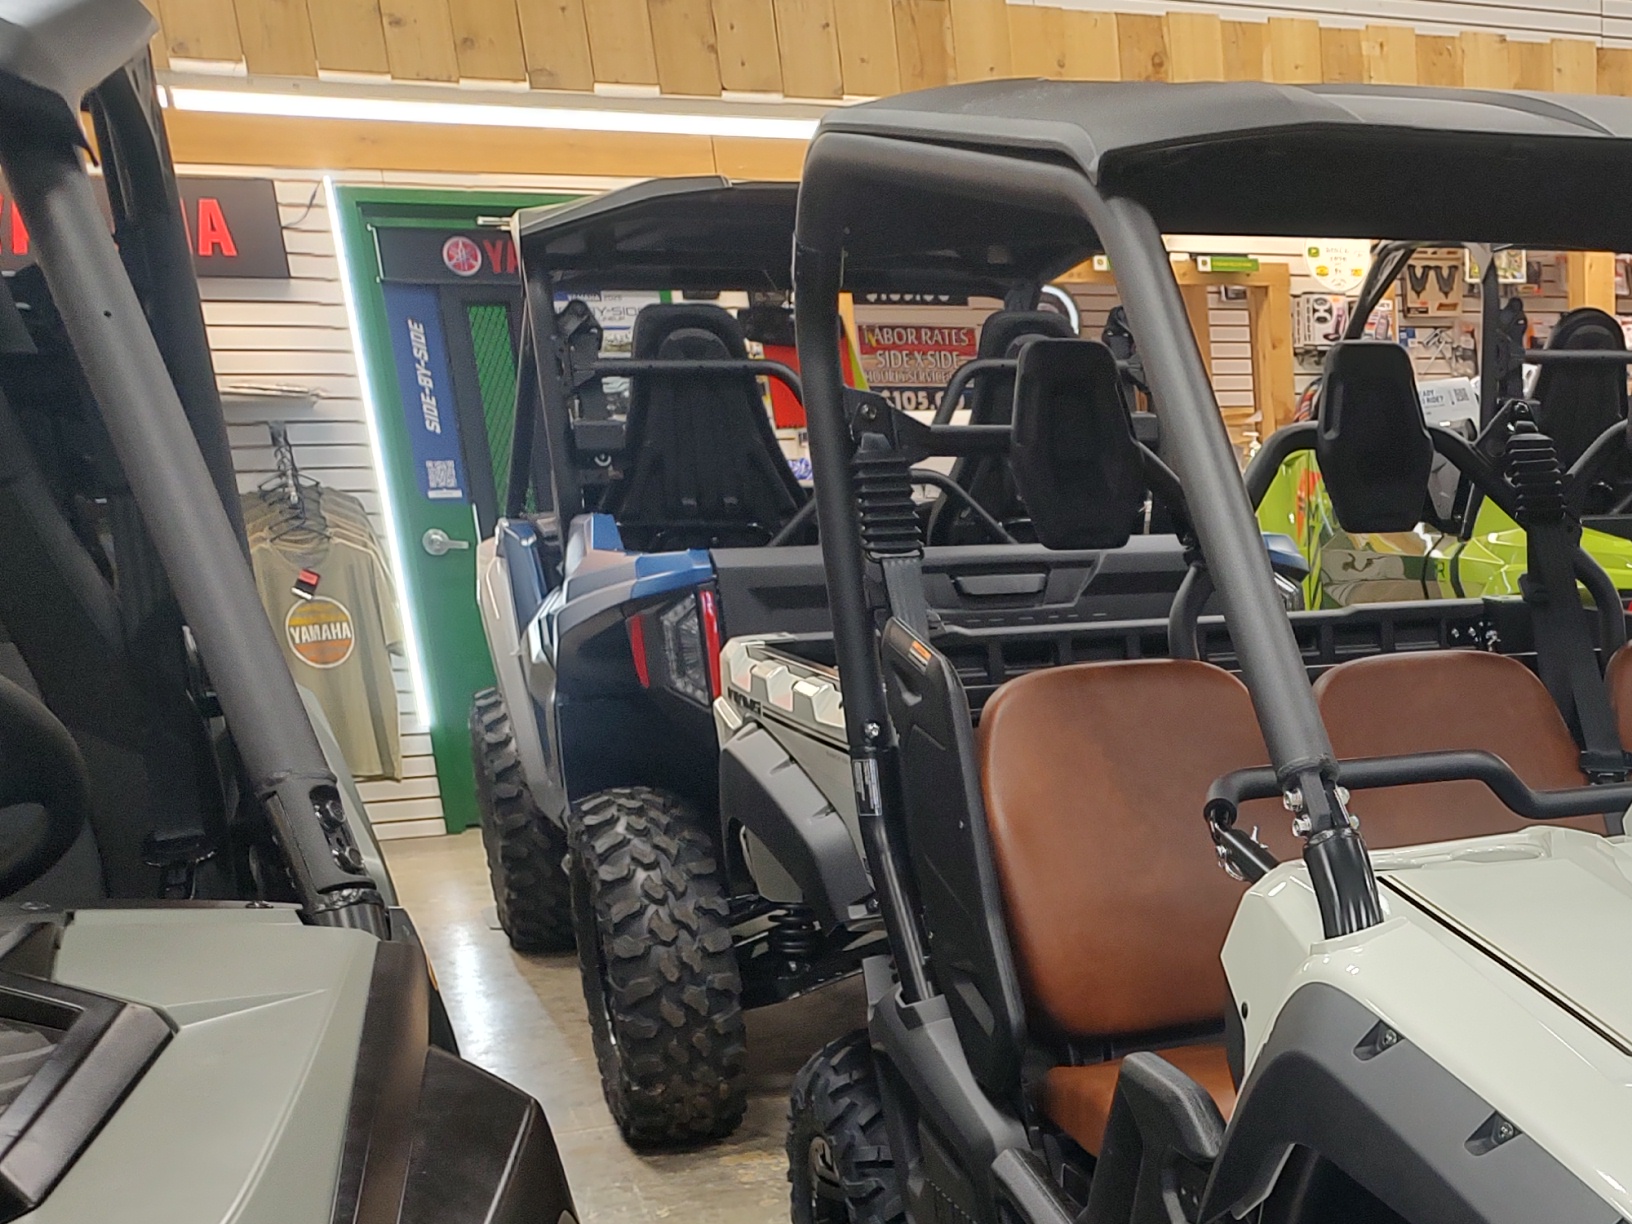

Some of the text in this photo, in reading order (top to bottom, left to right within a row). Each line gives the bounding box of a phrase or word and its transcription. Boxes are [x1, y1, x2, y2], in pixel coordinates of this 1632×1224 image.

[864, 326, 969, 346] LABOR RATES
[877, 350, 960, 369] SIDE X SIDE
[407, 319, 441, 434] SIDE-BY-SIDE
[289, 621, 352, 644] YAMAHA
